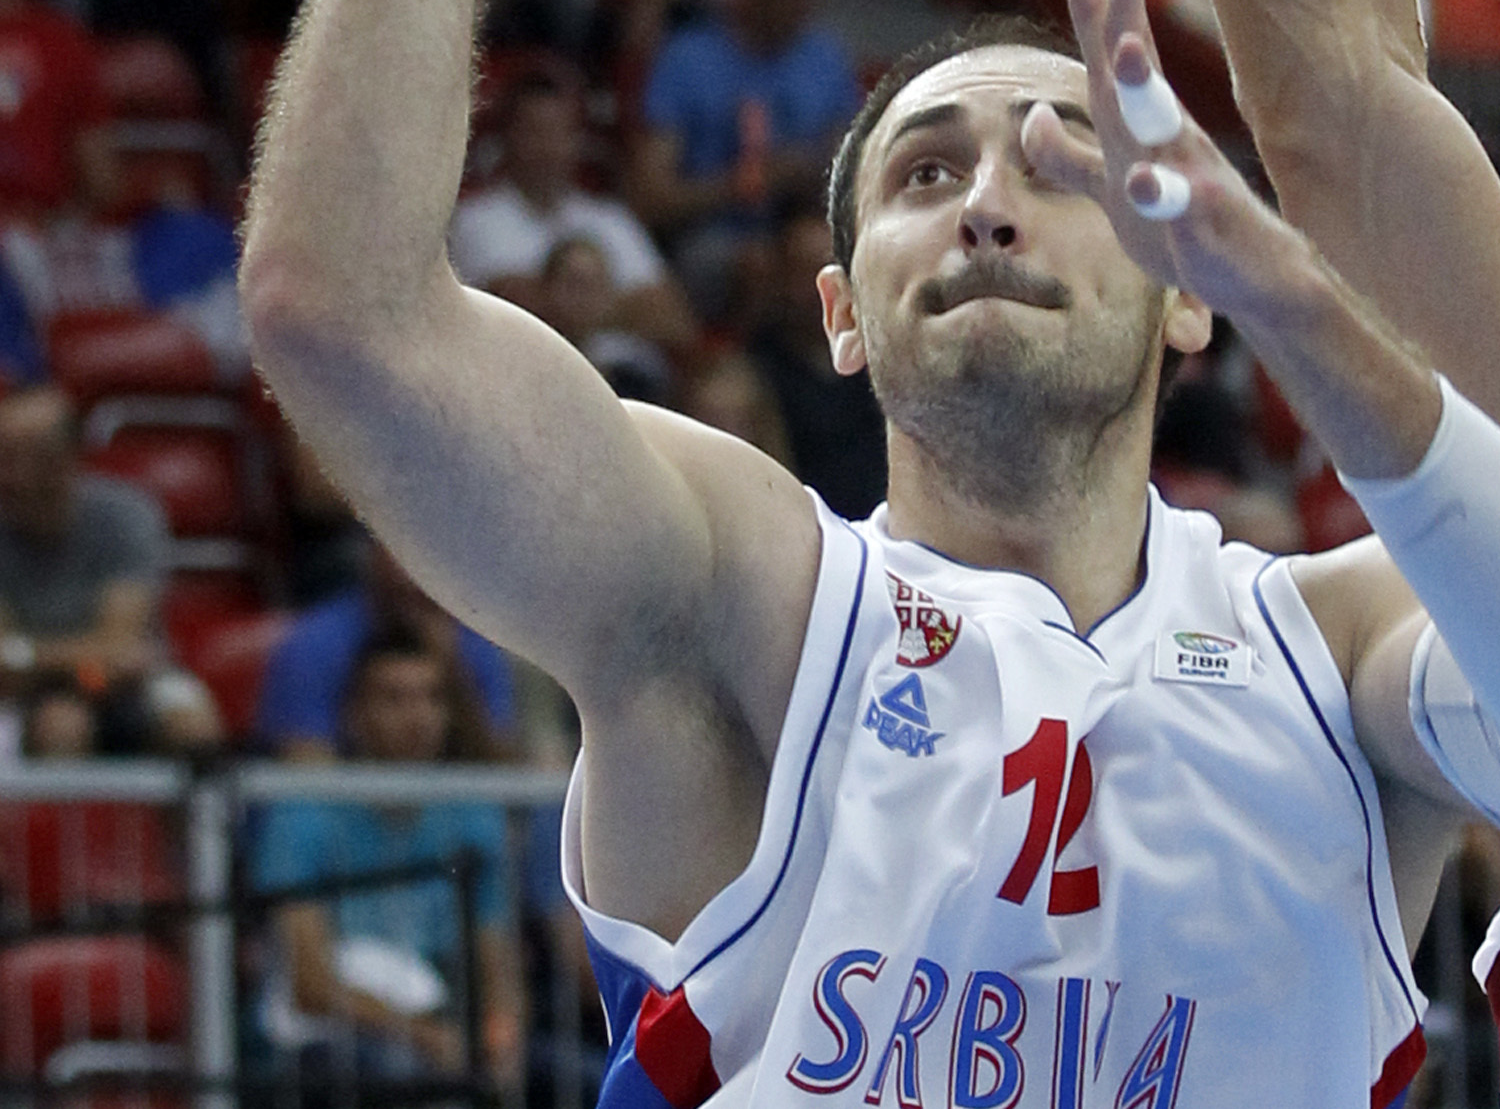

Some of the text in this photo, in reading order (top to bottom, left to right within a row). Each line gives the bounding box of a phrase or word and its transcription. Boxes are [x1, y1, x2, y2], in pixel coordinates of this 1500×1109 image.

[1177, 653, 1229, 669] FIBA
[861, 695, 947, 758] PEAK
[785, 949, 1197, 1109] SRBIA
